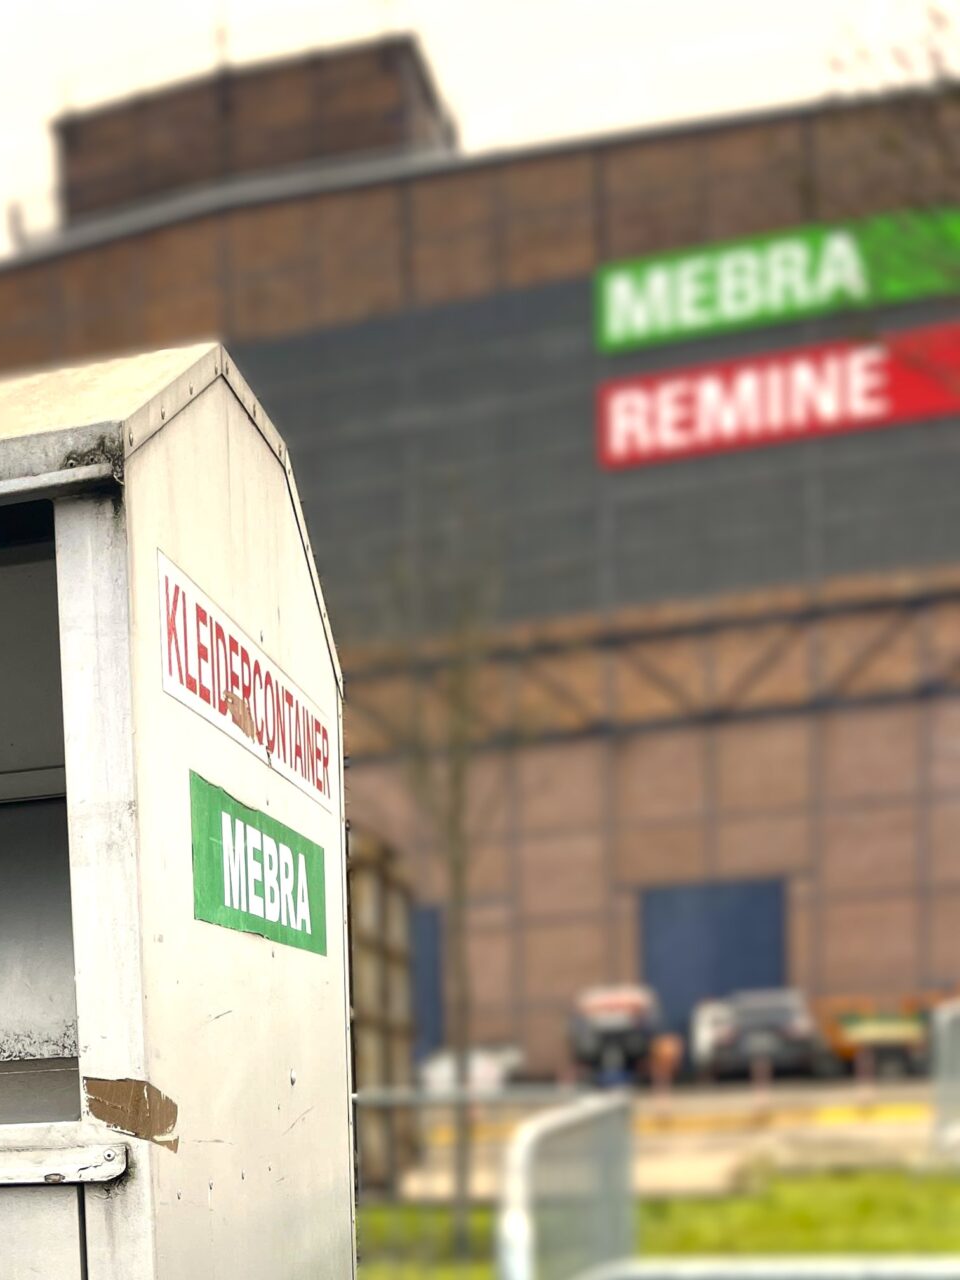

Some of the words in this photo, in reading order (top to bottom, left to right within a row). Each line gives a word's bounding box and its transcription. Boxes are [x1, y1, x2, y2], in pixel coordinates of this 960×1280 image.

[604, 229, 869, 342] MEBRA
[608, 345, 889, 458] REMINE
[164, 575, 331, 799] KLEIDERCONTAINER
[221, 811, 312, 935] MEBRA
